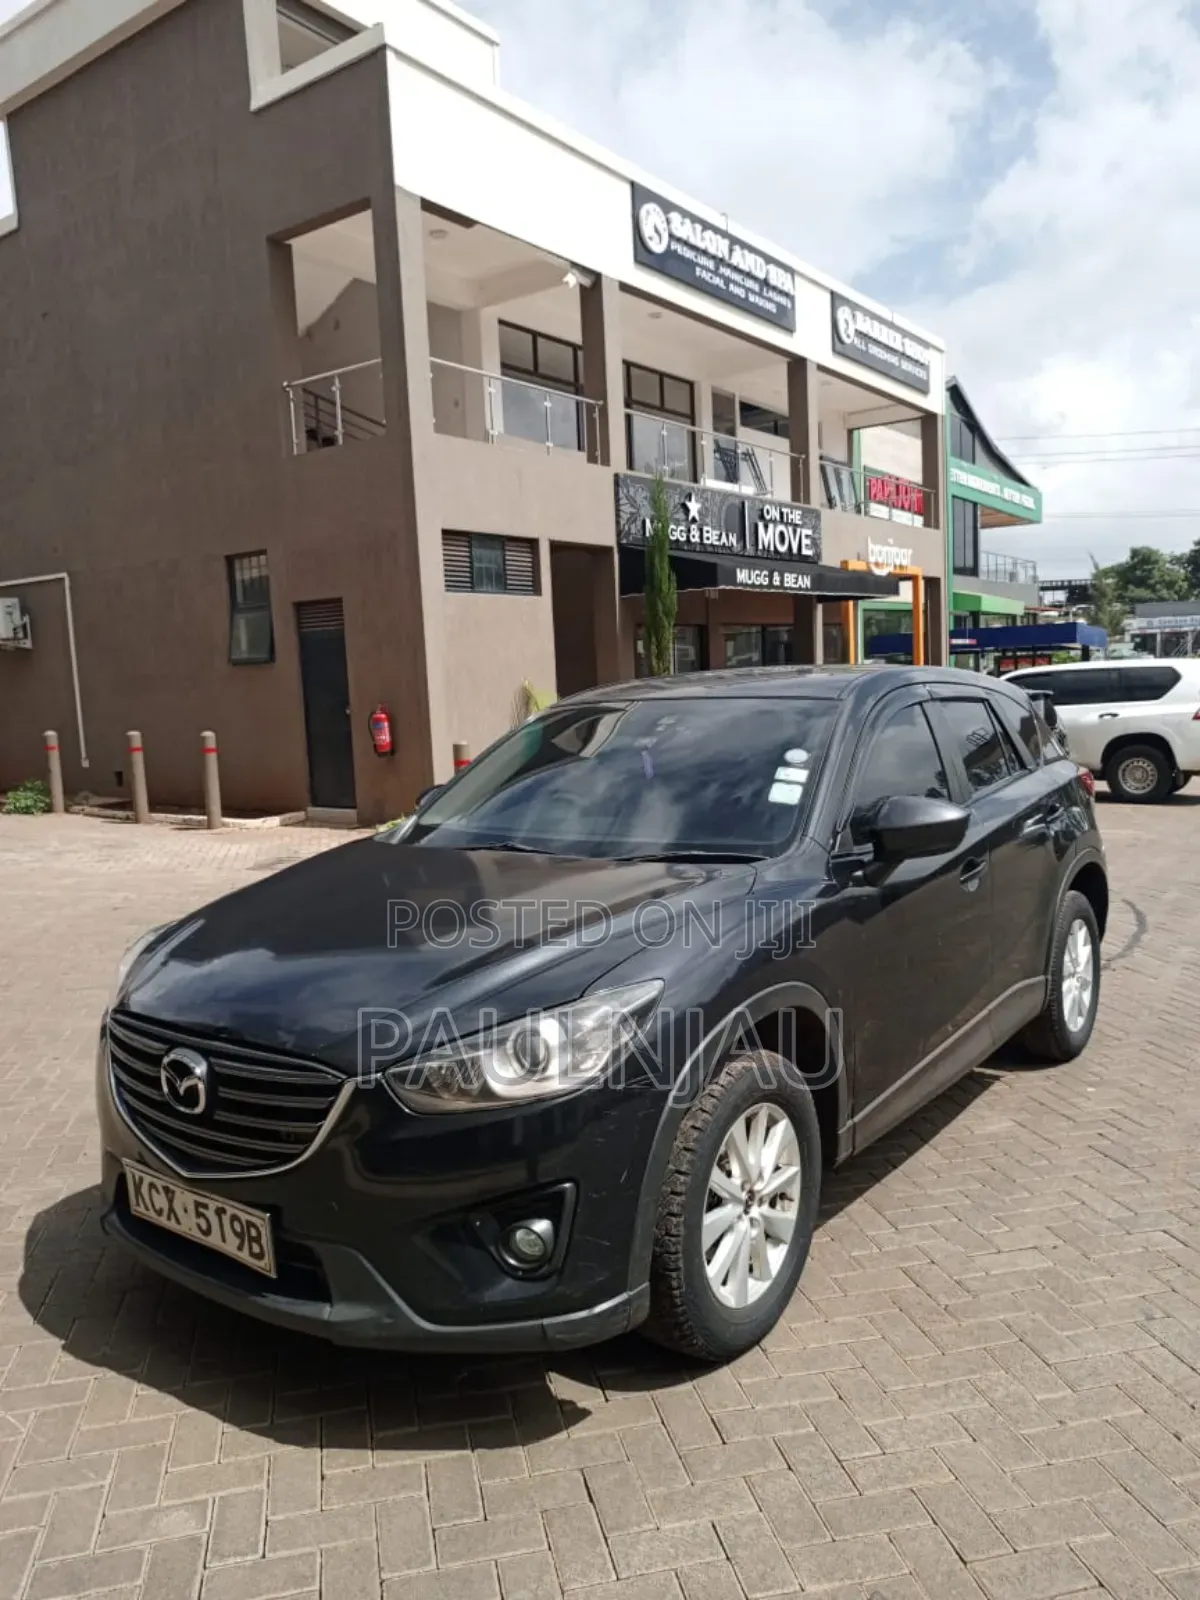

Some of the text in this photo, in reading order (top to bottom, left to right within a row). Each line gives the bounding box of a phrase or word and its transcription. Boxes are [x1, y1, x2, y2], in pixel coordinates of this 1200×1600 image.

[668, 211, 731, 260] SALON
[731, 244, 767, 279] AND
[670, 240, 716, 271] PEDICURE
[695, 266, 727, 290] FACIAL
[763, 504, 802, 525] ON THE
[645, 518, 737, 547] MGG & BEAN
[757, 521, 814, 556] MOVE
[736, 568, 811, 589] MUGG & BEAN
[131, 1173, 181, 1226] KCX
